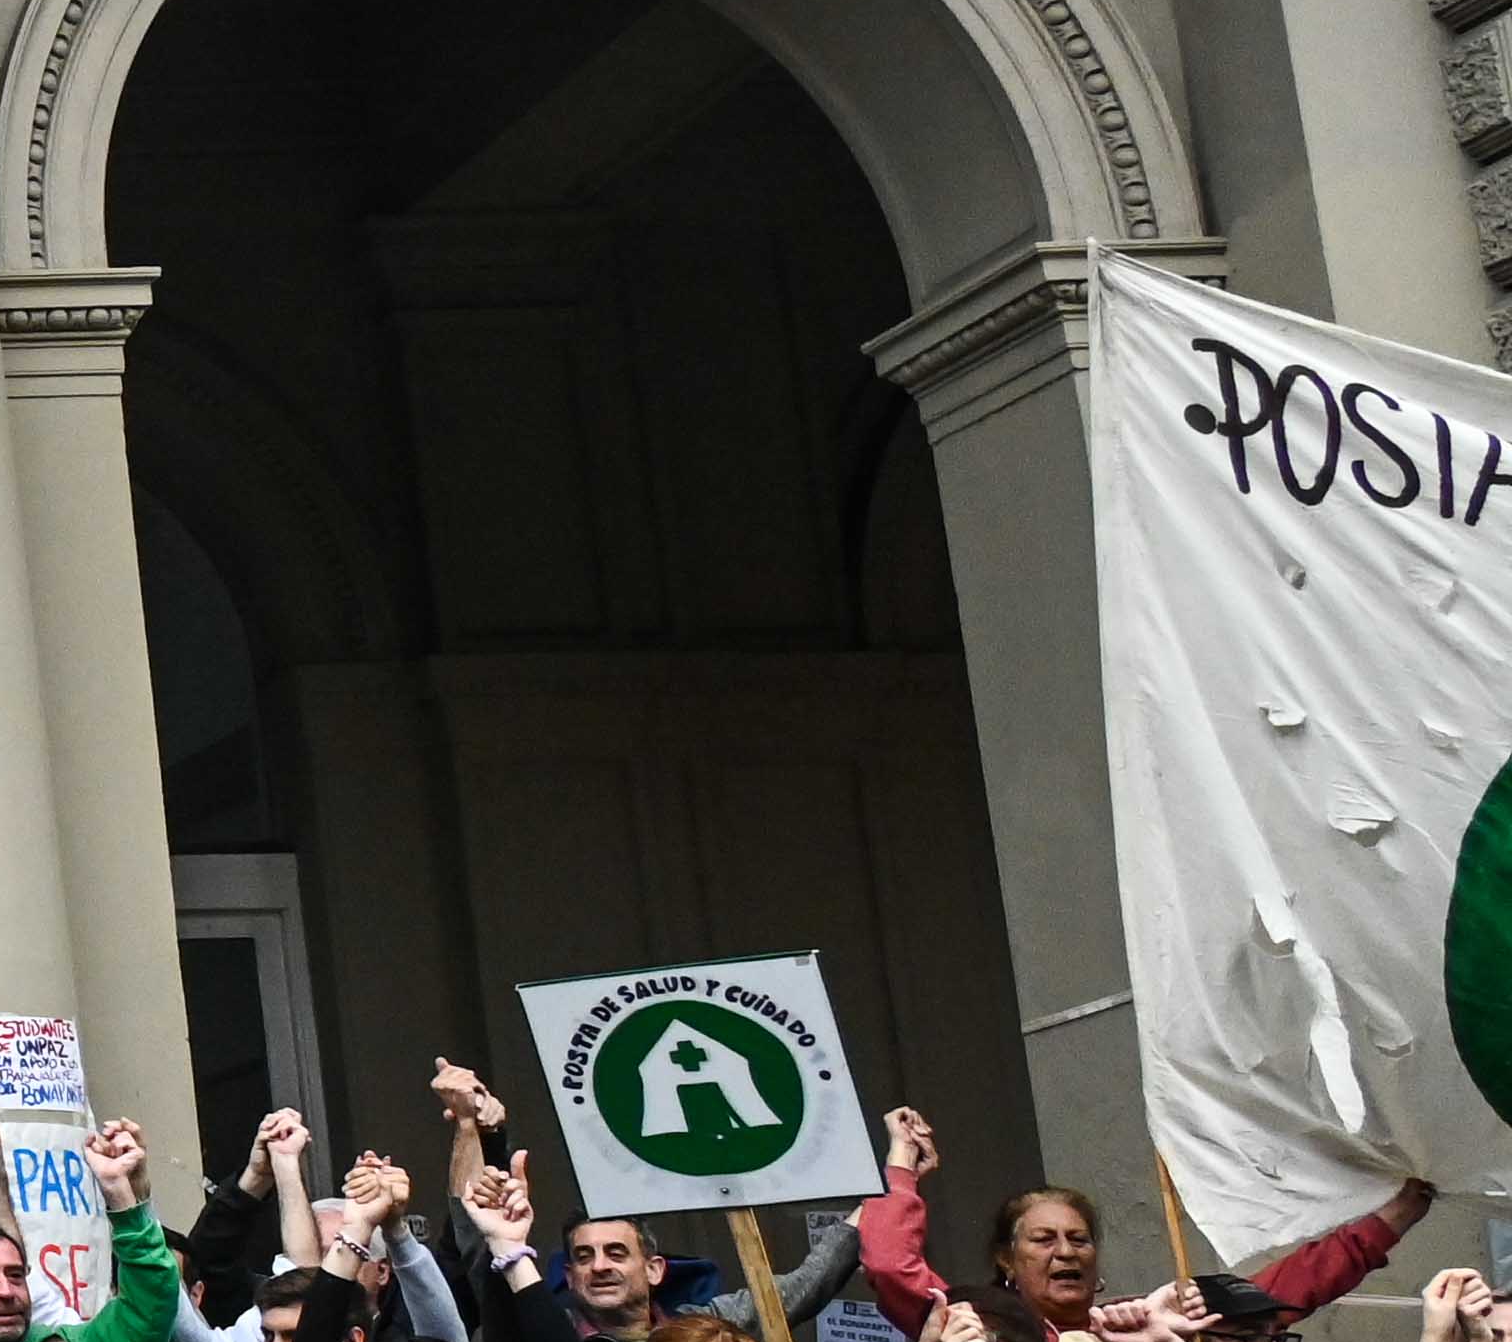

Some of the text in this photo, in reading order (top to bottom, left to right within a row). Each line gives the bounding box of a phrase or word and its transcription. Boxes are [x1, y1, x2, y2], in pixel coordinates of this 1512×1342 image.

[562, 1020, 601, 1091] POSTA
[591, 995, 621, 1025] DE
[617, 975, 697, 1004] SALUD
[706, 979, 720, 997] Y
[17, 1039, 69, 1058] UNPAZ
[20, 1055, 57, 1069] APOYO
